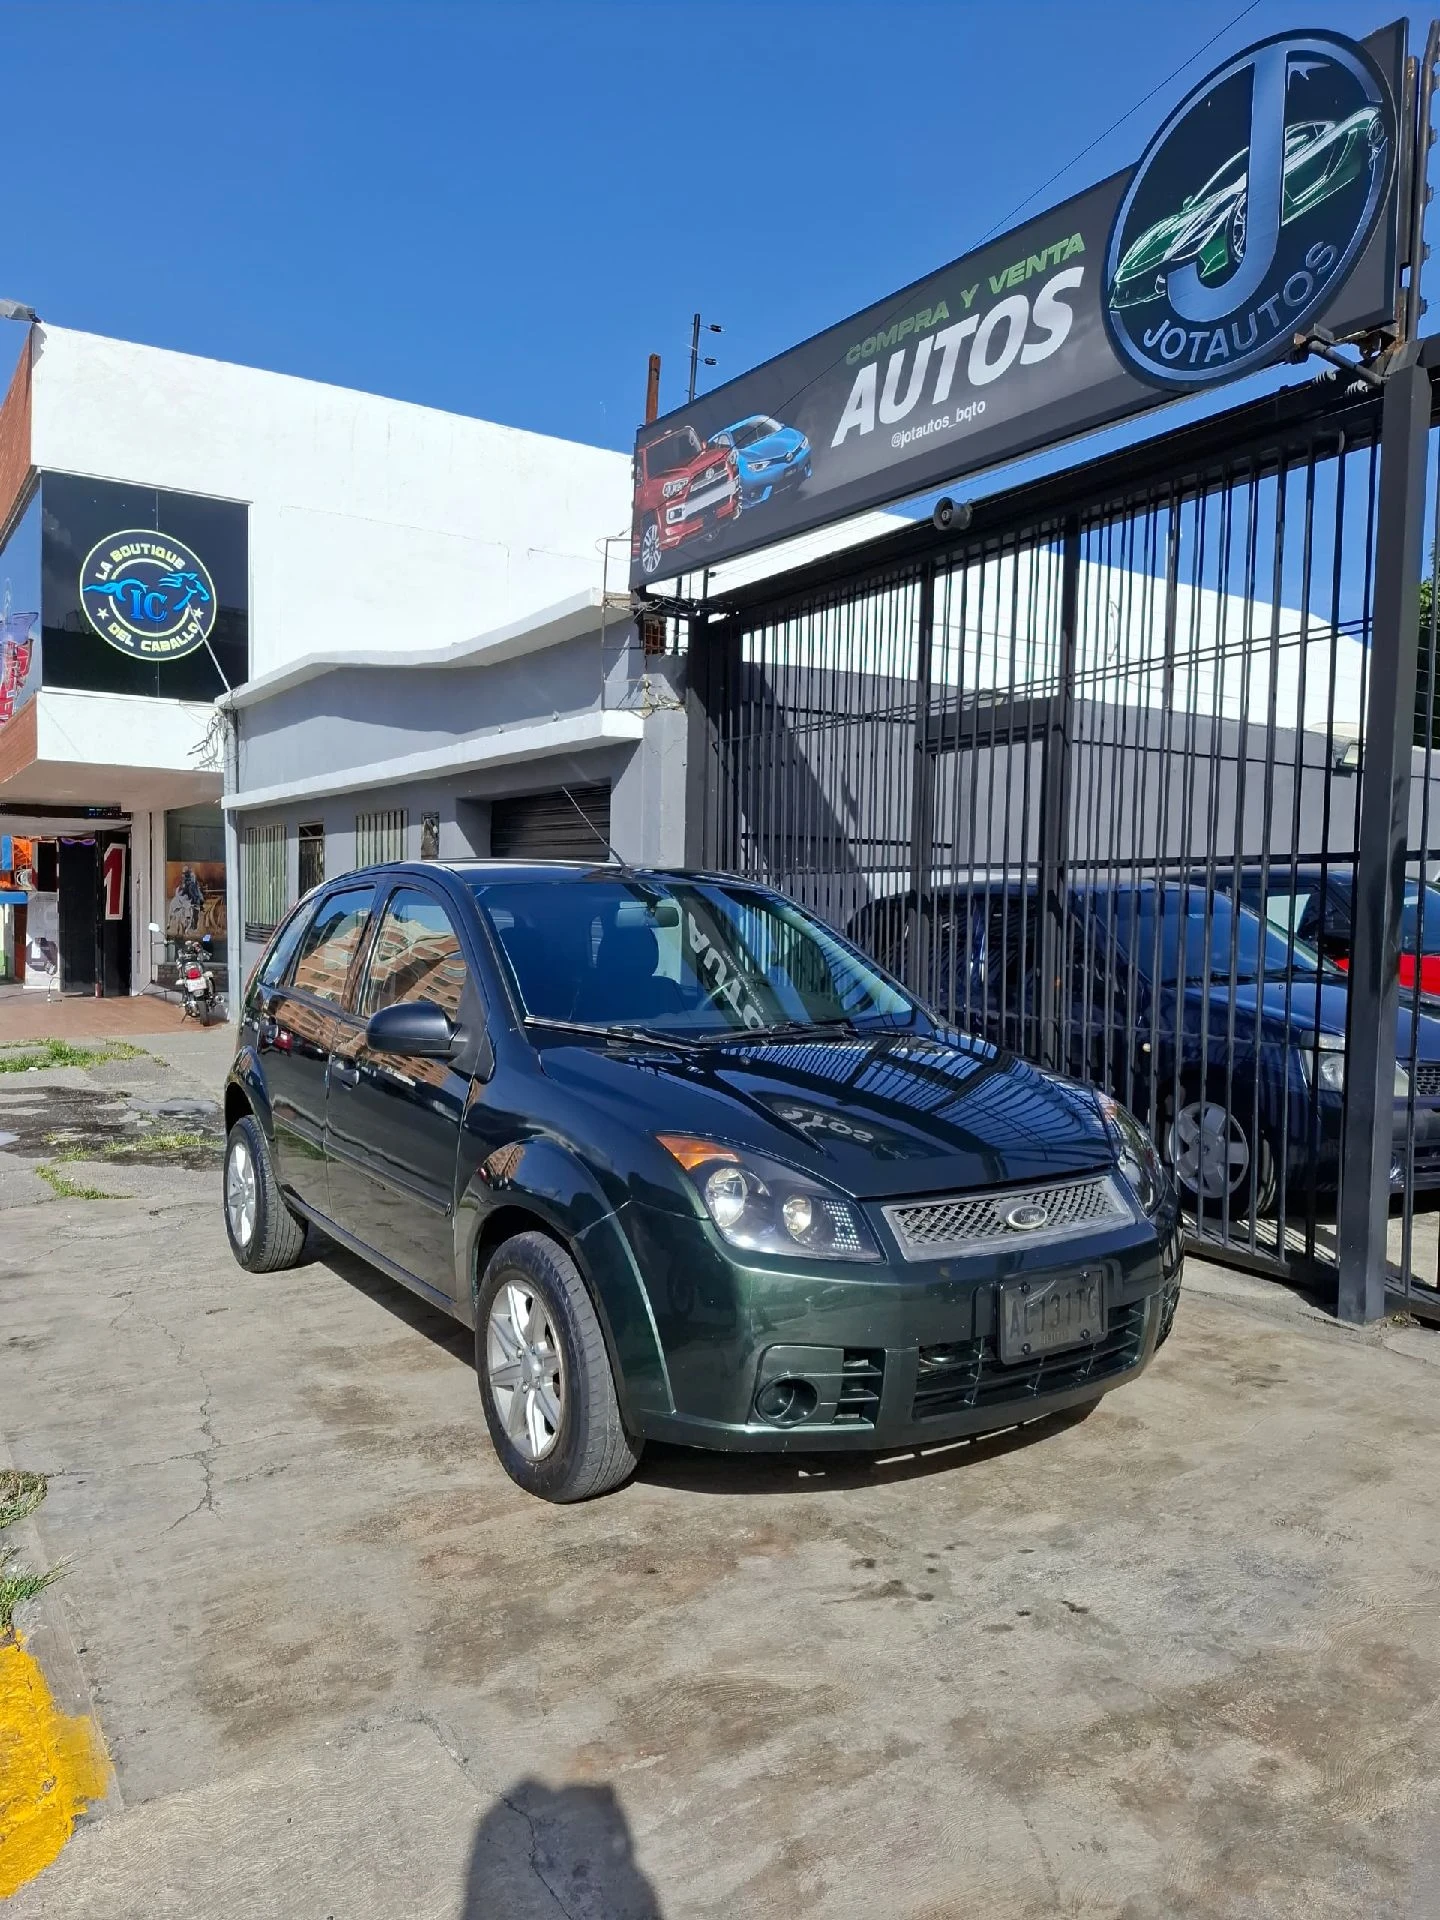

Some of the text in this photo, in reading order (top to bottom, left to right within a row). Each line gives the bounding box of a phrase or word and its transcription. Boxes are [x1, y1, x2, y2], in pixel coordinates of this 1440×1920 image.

[845, 232, 1086, 365] COMPRA Y VENTA
[1143, 240, 1337, 364] JOTAUTOS
[831, 266, 1085, 448] AUTOS
[891, 400, 986, 448] @jotautos_bqto
[95, 543, 186, 581] LA BOUTIQUE
[107, 622, 200, 652] DEL CABALLO
[103, 843, 126, 921] 1
